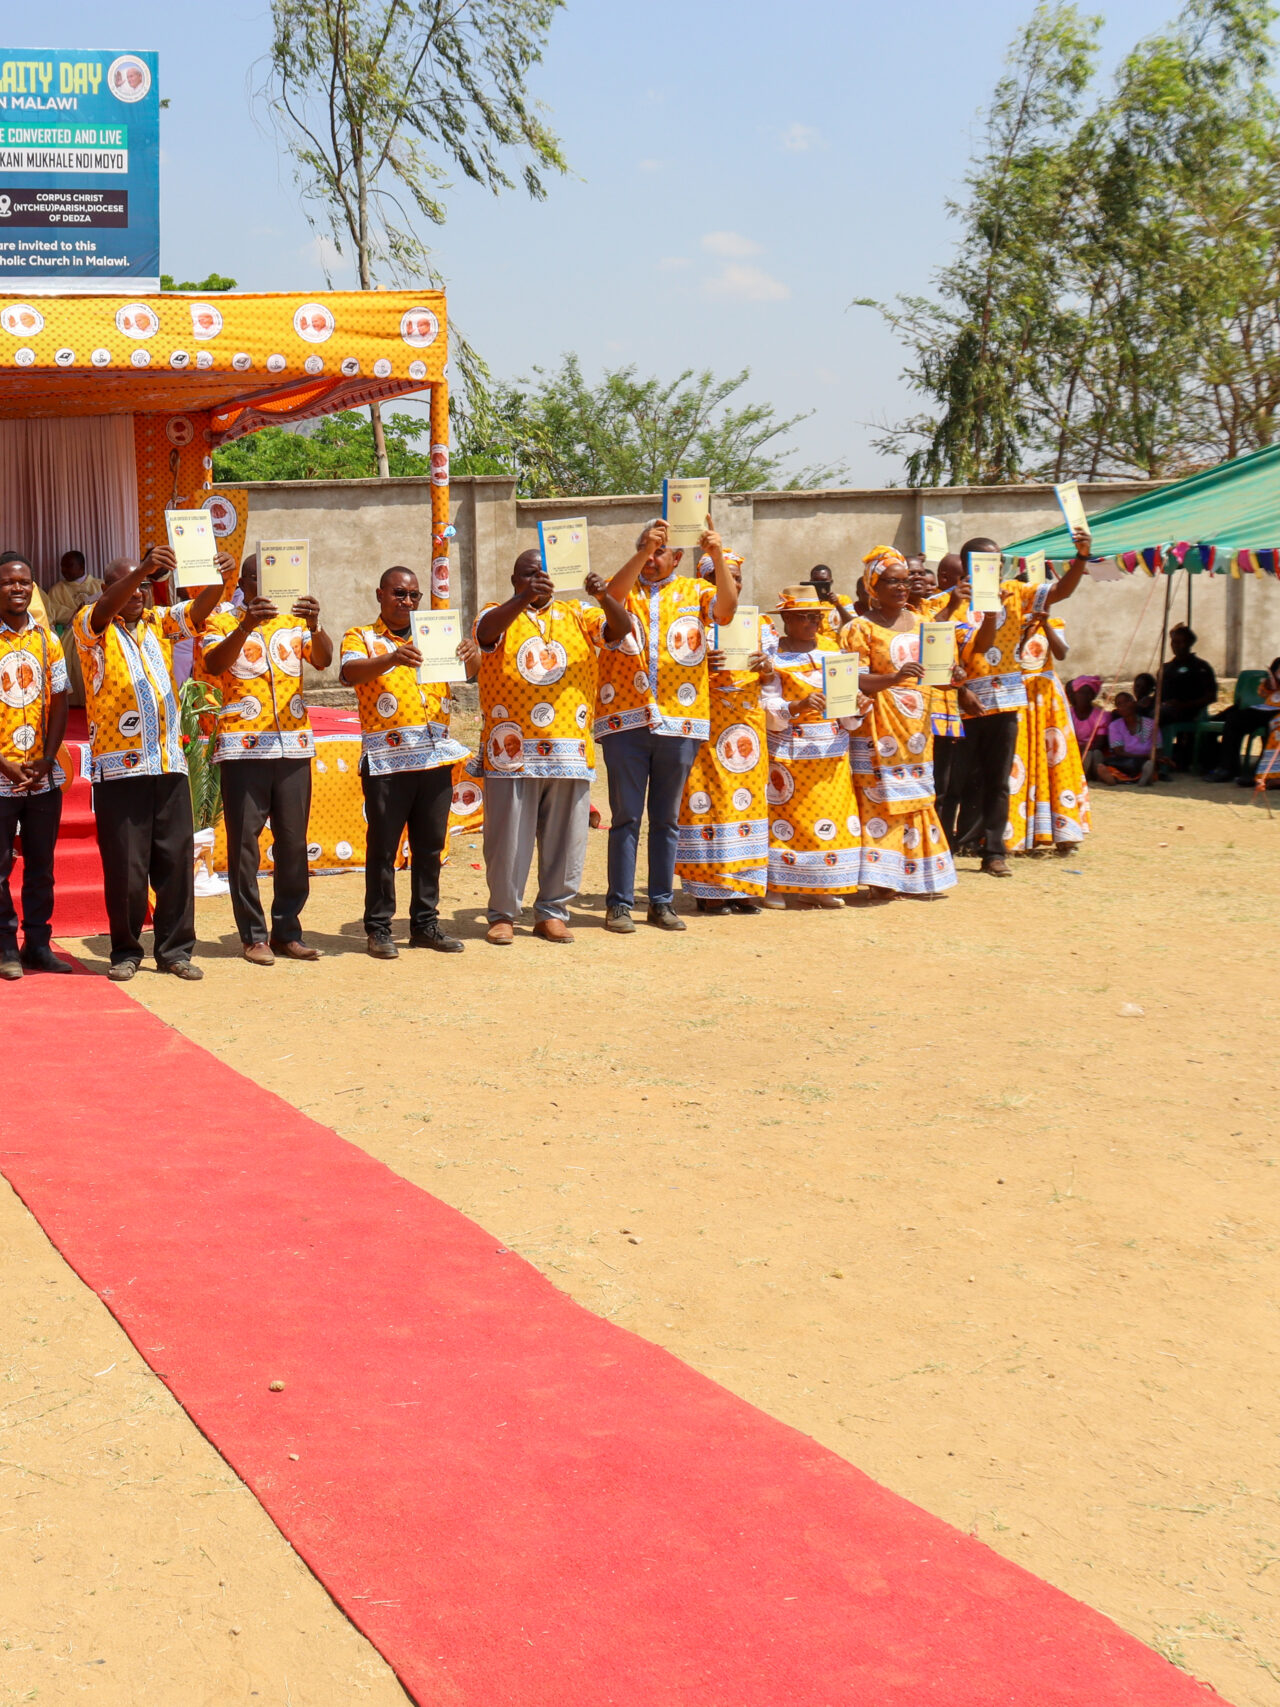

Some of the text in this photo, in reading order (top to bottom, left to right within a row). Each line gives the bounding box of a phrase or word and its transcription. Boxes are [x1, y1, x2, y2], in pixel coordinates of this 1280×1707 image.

[60, 62, 102, 94] DAY
[11, 96, 77, 110] MALAWI
[8, 128, 71, 144] CONVERTED
[74, 129, 97, 144] AND
[99, 130, 122, 145] LIVE
[94, 154, 123, 169] MOYO
[36, 193, 103, 202] CORPUS CHRIST
[49, 214, 91, 222] OF DEDZA
[18, 240, 58, 251] invited
[60, 241, 73, 251] to
[74, 240, 96, 251] this
[29, 256, 70, 266] Church
[72, 256, 83, 266] in
[85, 256, 130, 266] Malawi.
